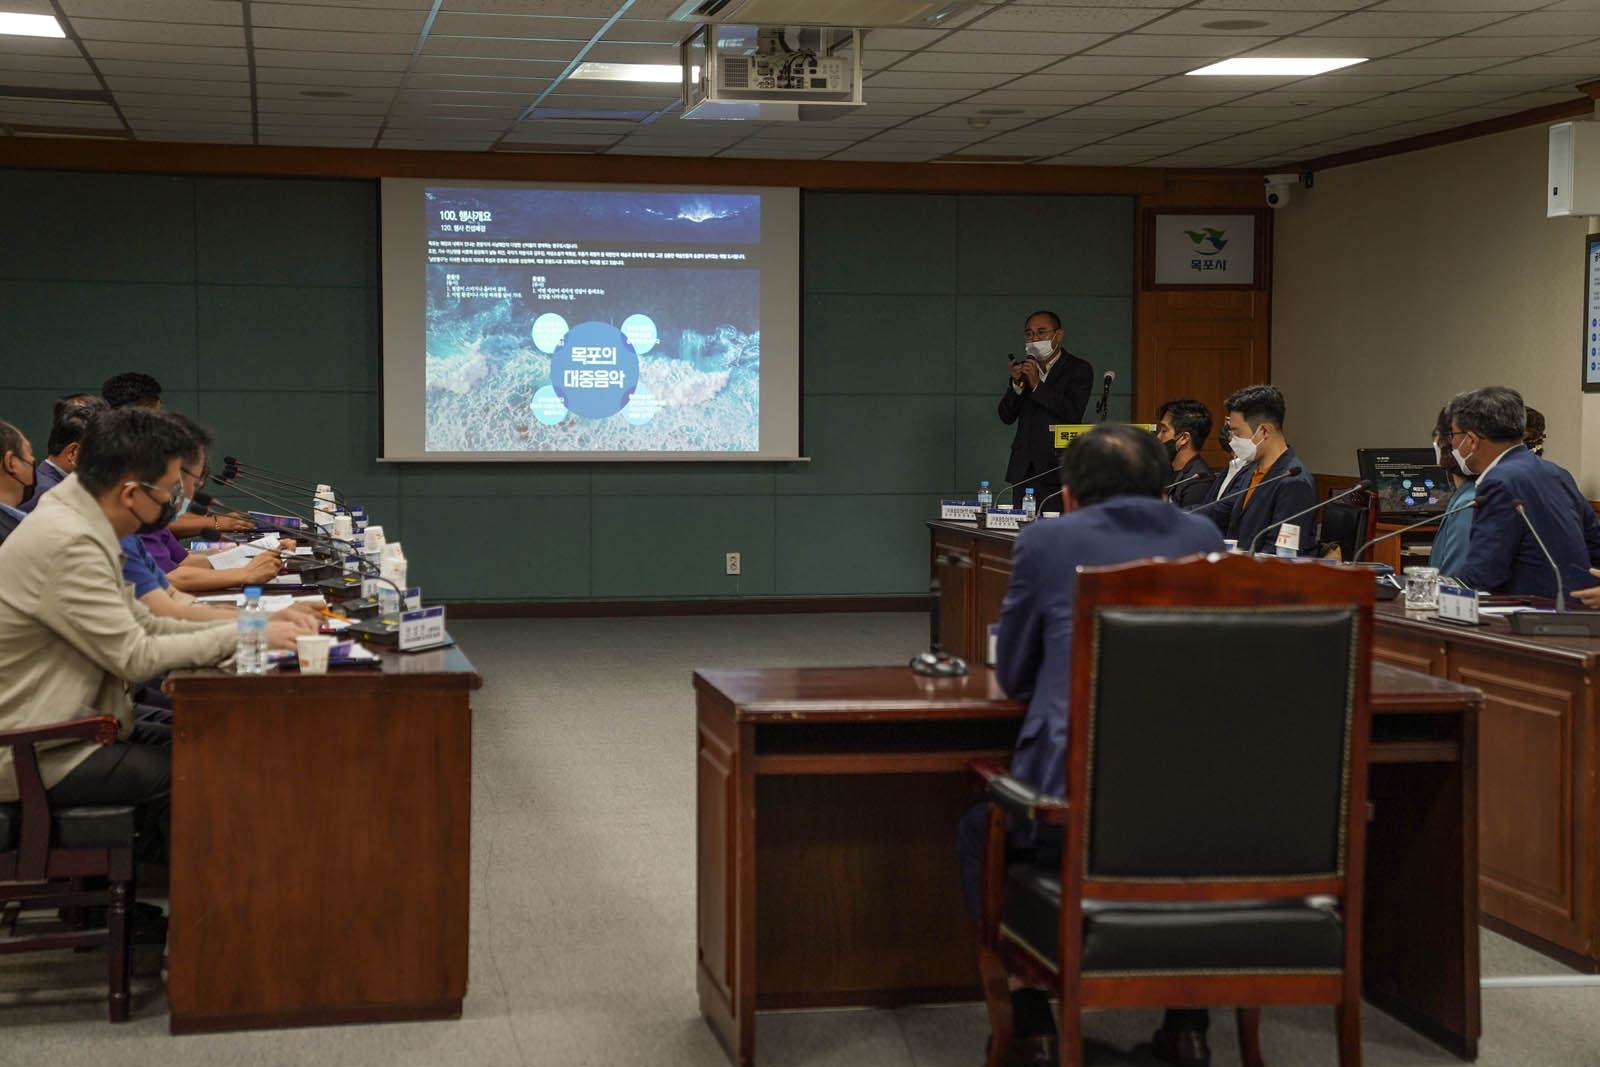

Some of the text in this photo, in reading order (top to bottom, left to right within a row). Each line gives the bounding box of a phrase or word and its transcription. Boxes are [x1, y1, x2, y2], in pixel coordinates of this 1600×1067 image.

[440, 210, 492, 222] 100. 행사개요
[1191, 258, 1226, 272] 목포시
[571, 346, 617, 366] 목포의
[563, 369, 625, 389] 대중음악
